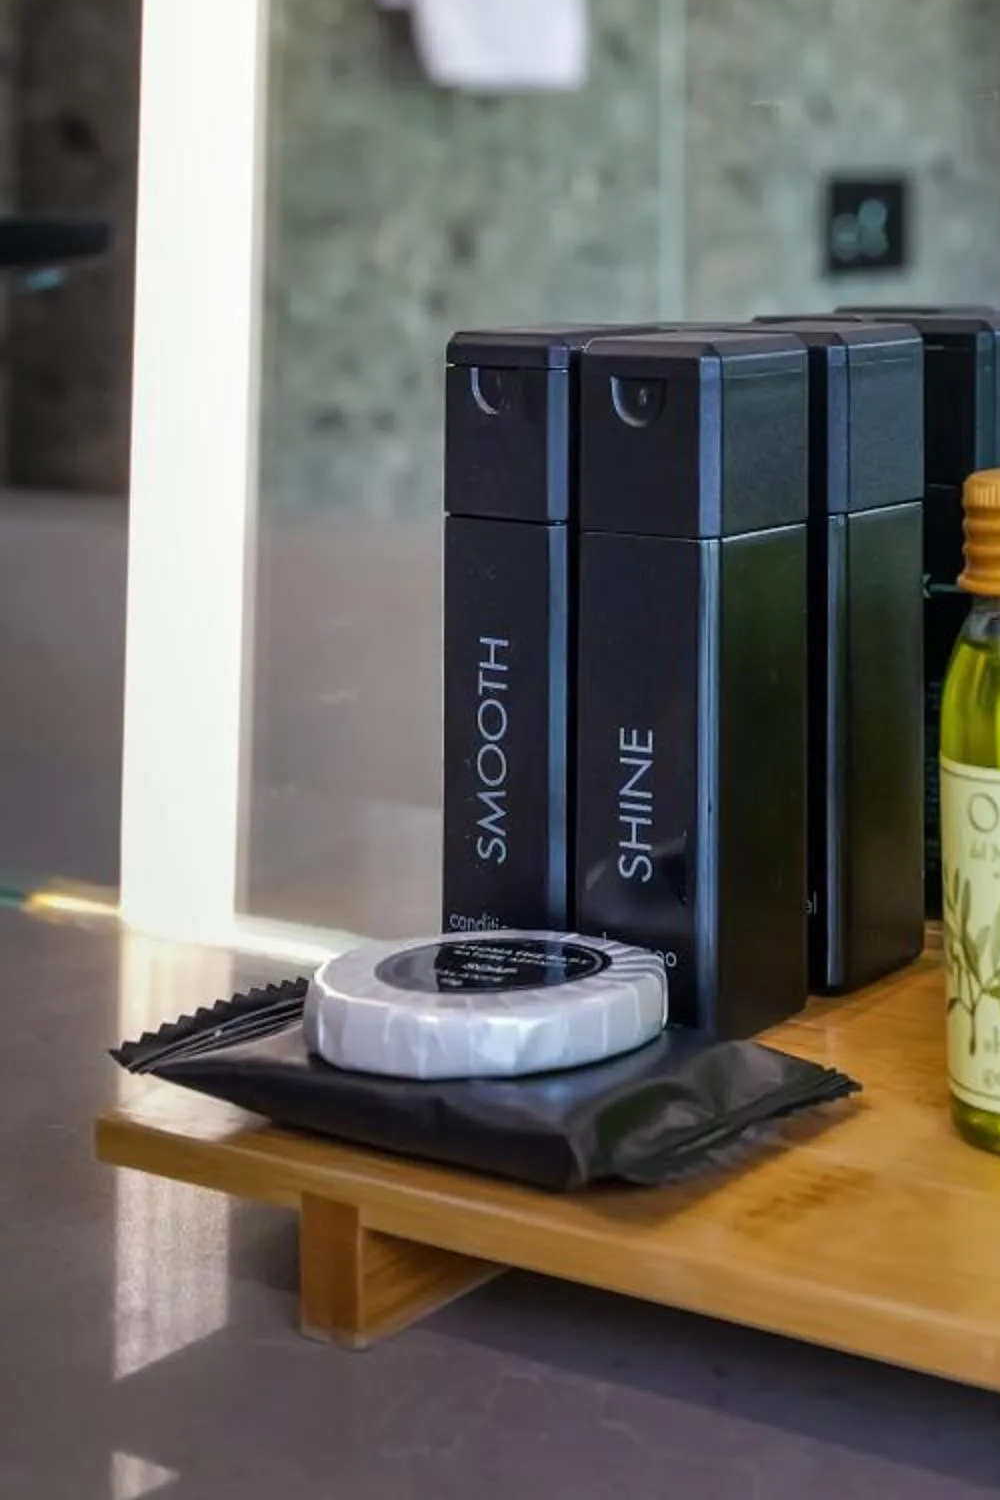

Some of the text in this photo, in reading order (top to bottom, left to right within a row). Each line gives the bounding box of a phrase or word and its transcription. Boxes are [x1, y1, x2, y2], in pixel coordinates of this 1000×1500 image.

[476, 635, 509, 865] SMOOTH
[618, 726, 654, 883] SHINE
[450, 913, 508, 931] conditi
